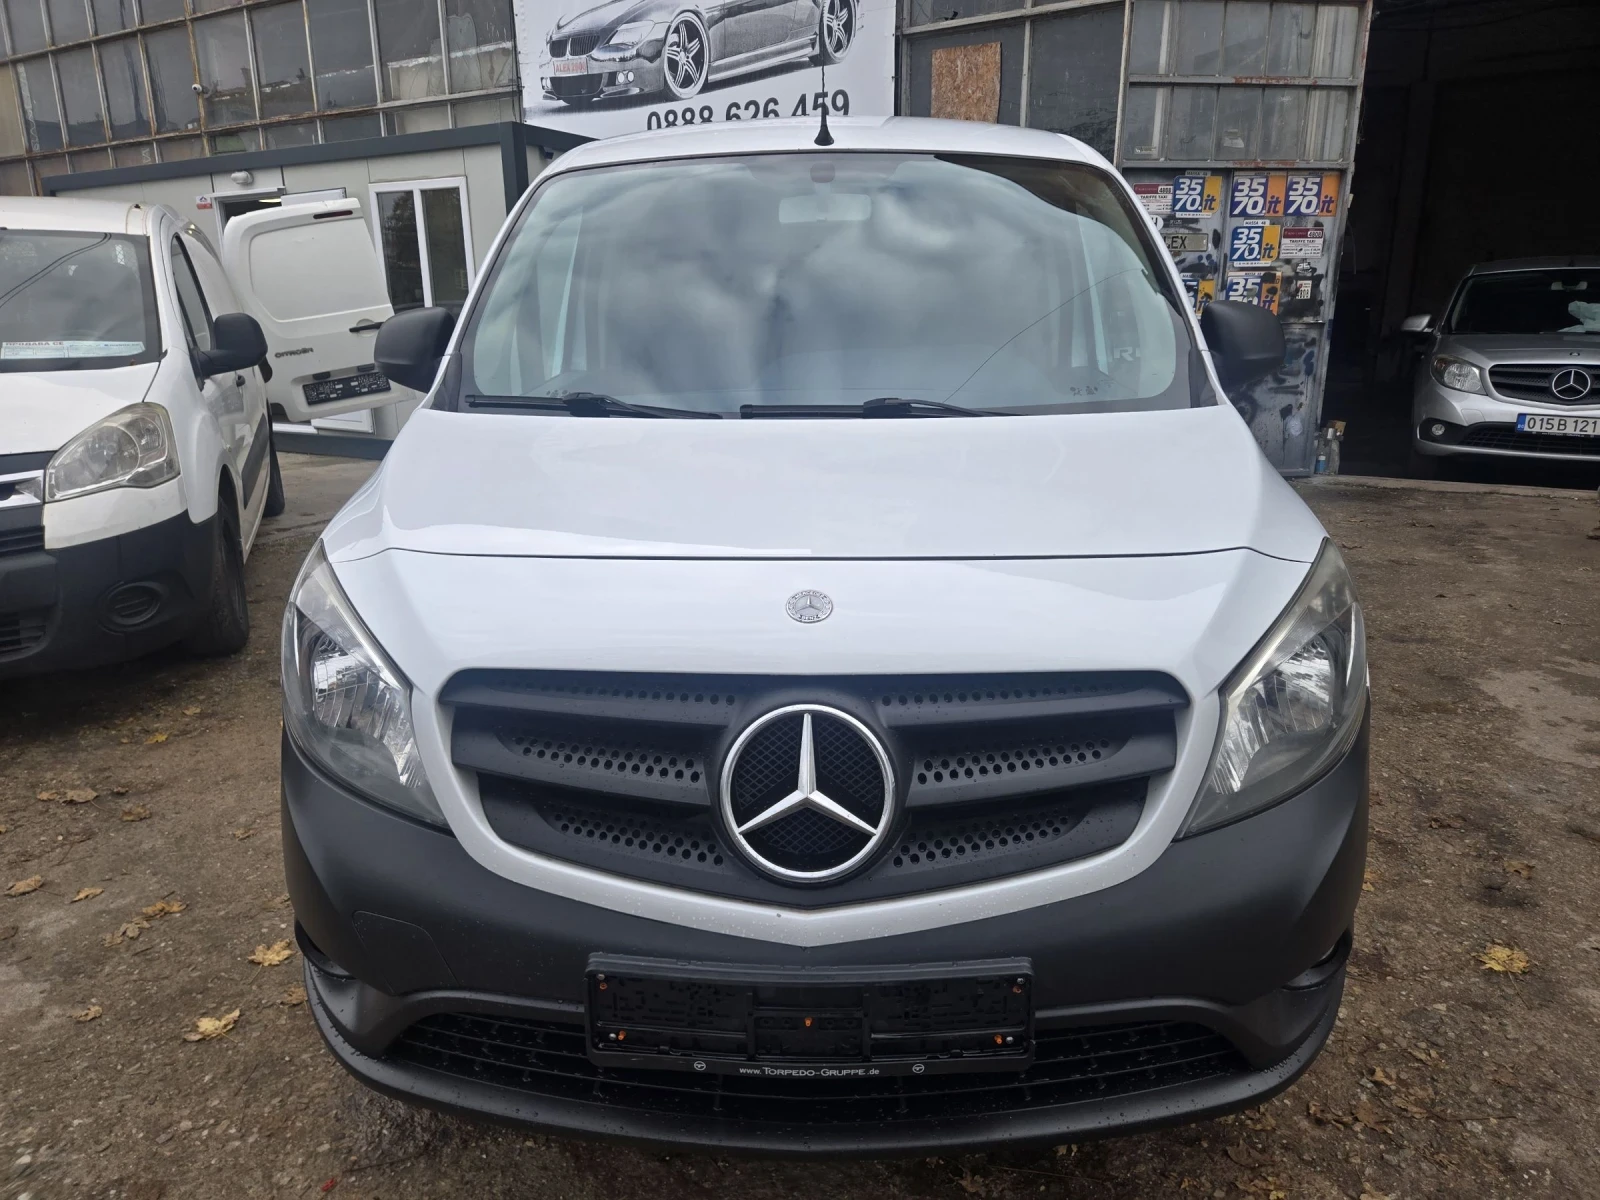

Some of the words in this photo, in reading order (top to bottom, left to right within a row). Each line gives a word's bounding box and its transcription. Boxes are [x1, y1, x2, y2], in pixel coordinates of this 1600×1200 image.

[647, 105, 713, 130] 0888
[726, 97, 780, 121] 626
[792, 89, 850, 116] 459
[1176, 178, 1204, 195] 35
[1234, 177, 1267, 197] 35
[1288, 177, 1321, 196] 35
[1233, 228, 1262, 244] 35
[1573, 419, 1598, 433] 121
